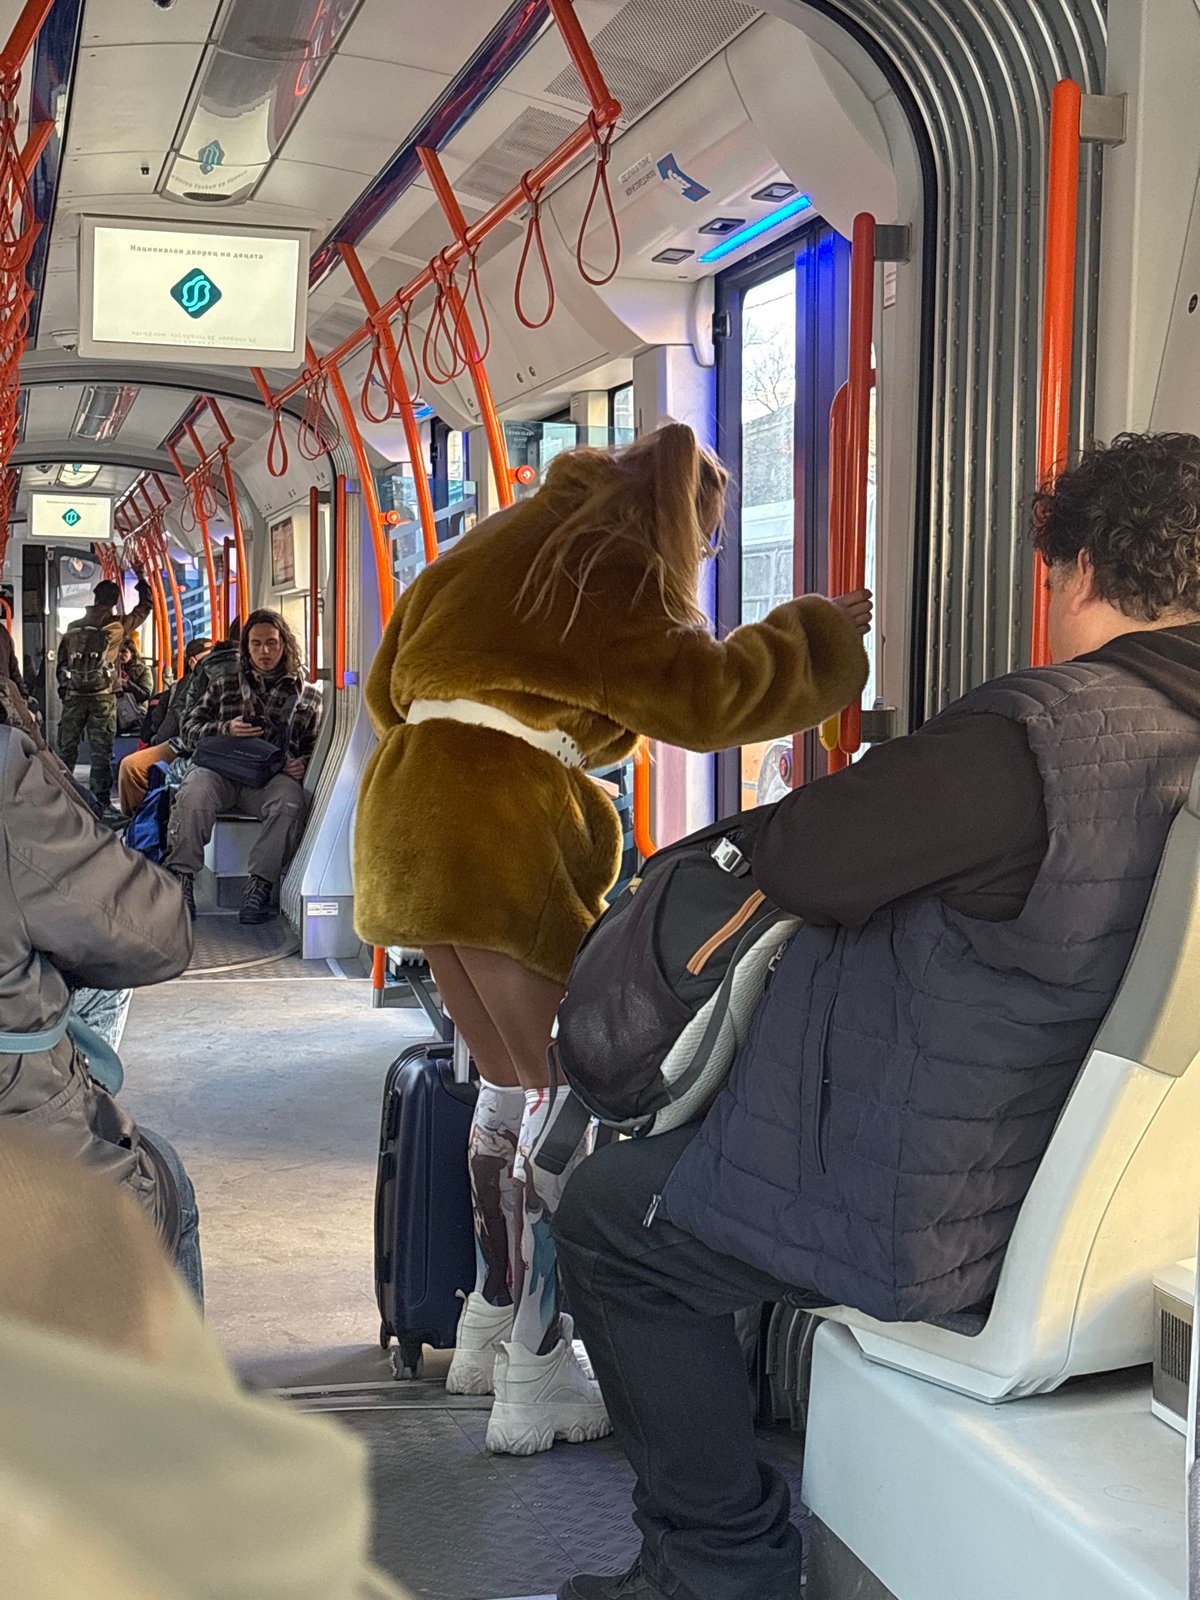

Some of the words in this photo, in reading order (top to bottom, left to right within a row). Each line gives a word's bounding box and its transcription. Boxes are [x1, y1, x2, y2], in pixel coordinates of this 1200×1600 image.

[130, 244, 184, 255] Национален
[186, 249, 218, 257] дворец
[233, 252, 264, 260] децата
